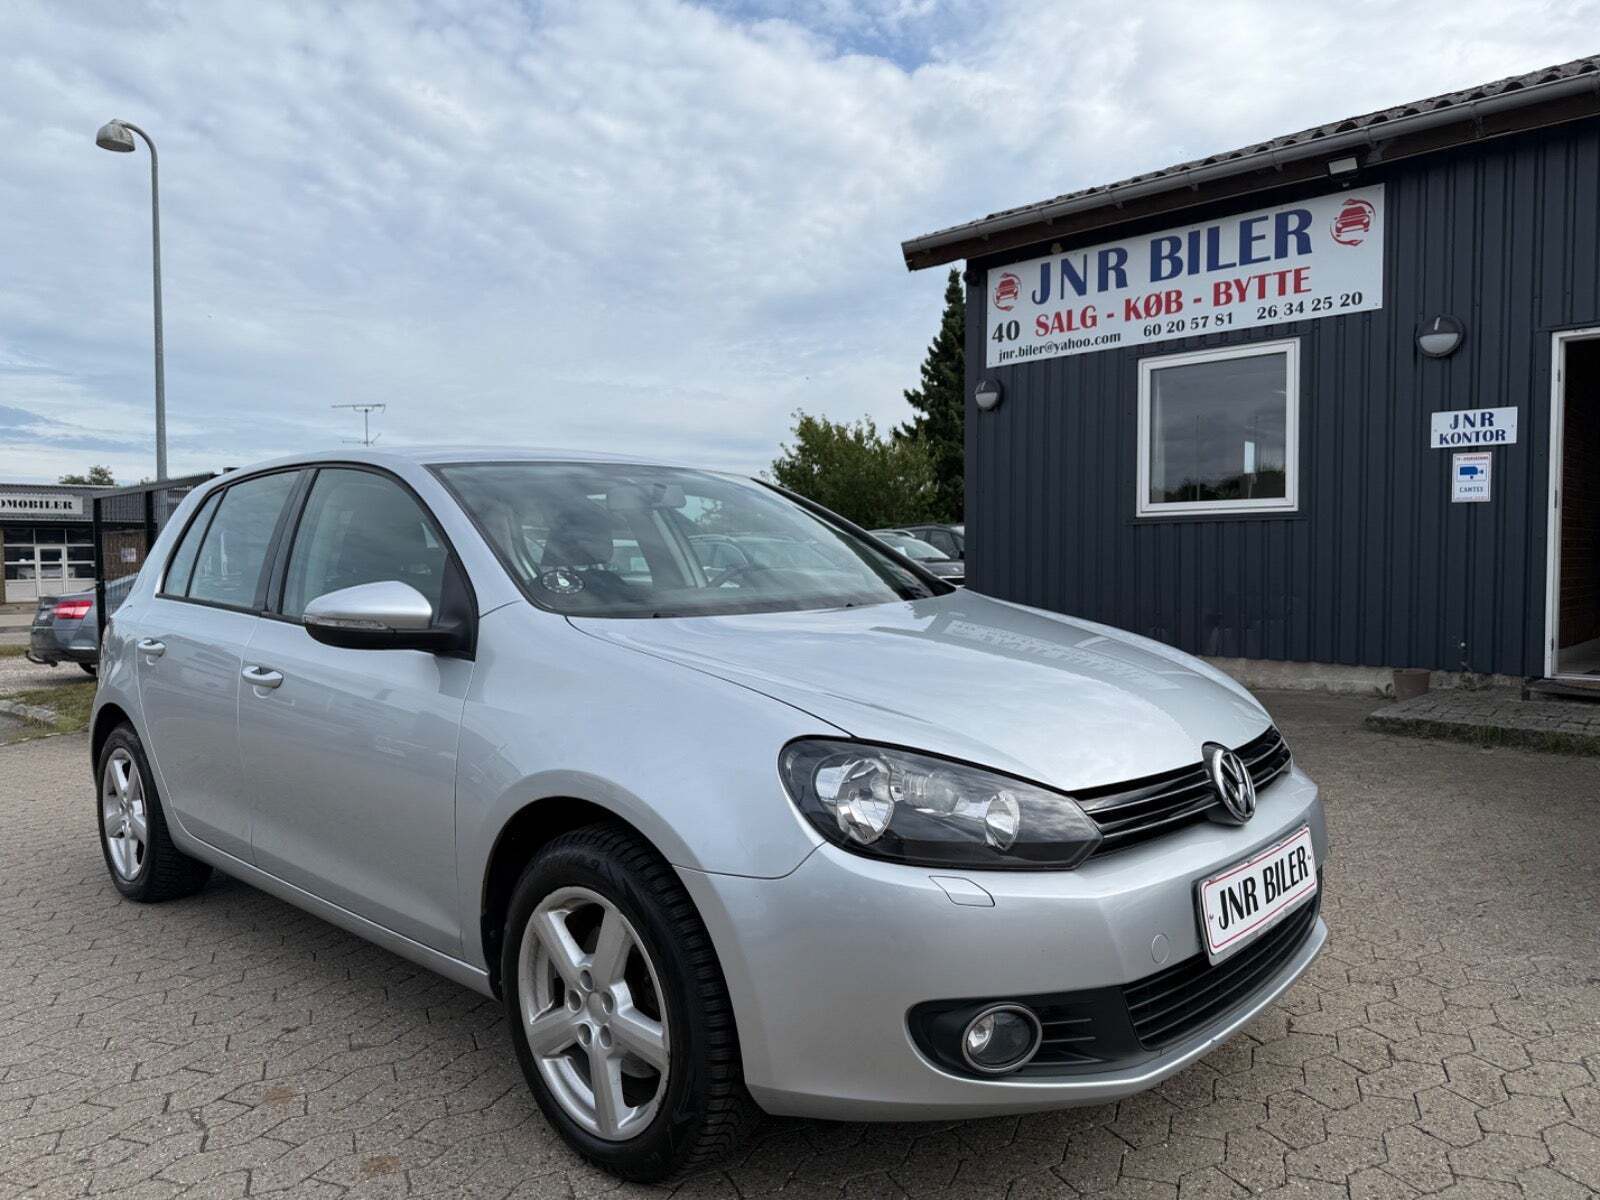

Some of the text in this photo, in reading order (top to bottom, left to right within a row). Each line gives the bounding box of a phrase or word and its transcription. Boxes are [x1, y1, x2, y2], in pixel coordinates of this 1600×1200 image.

[1031, 208, 1313, 305] JNR BILER
[1035, 305, 1098, 337] SALG
[1124, 289, 1184, 322] KØB
[1213, 266, 1312, 307] BYTTE
[1143, 291, 1363, 337] 60 20 57 81 26 34 25 20
[992, 320, 1020, 343] 40
[999, 332, 1121, 362] jnr.biler@yahoo.com
[1439, 429, 1507, 446] KONTOR
[1449, 411, 1495, 430] JNR
[1218, 845, 1309, 930] JNR BILER
